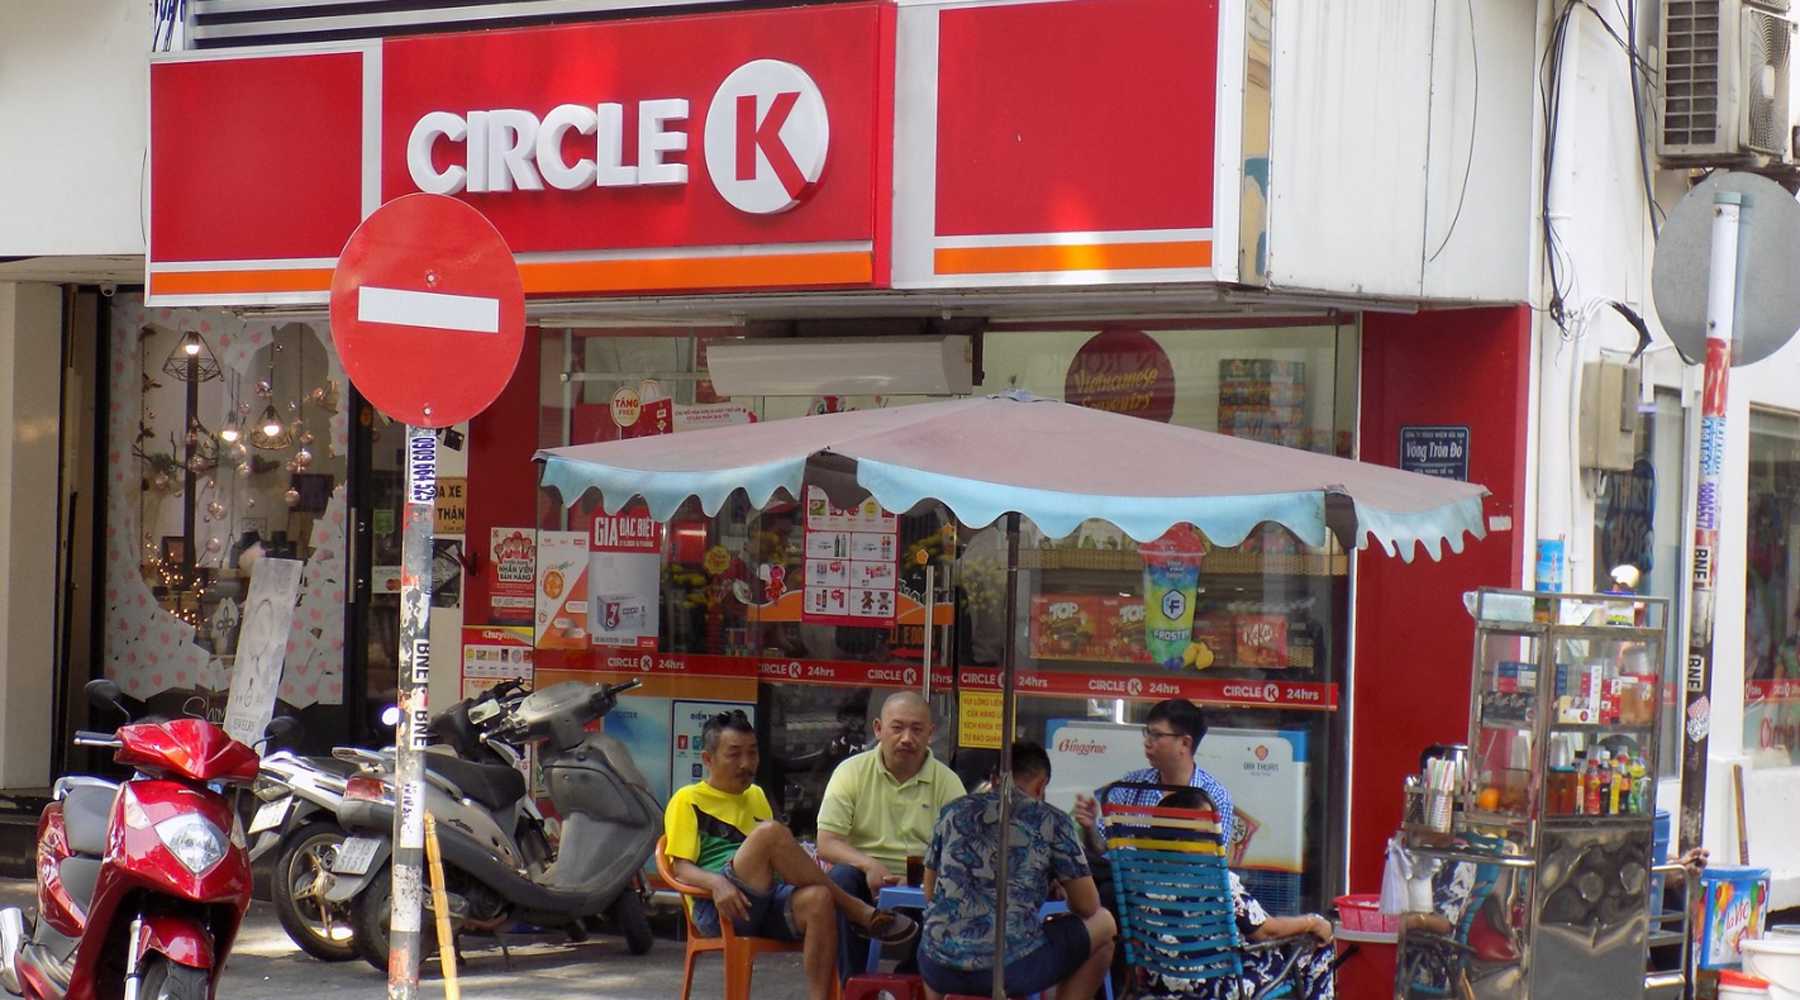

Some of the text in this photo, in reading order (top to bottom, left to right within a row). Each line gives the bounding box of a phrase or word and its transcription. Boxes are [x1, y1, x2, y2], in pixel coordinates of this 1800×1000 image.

[407, 98, 689, 195] CIRCLE
[1429, 441, 1448, 458] Tròn
[449, 486, 461, 497] XE
[416, 642, 430, 679] BNE
[608, 657, 638, 669] CIRCLE
[658, 658, 685, 670] 24hrs
[807, 666, 835, 677] 24hrs
[867, 669, 901, 681] CIRCLE
[961, 673, 996, 685] CIRCLE
[1018, 676, 1048, 689] 24hrs
[1088, 680, 1126, 692] CIRCLE
[1149, 683, 1180, 695] 24hrs
[1223, 685, 1262, 698] CIRCLE
[1286, 688, 1319, 701] 24hrs
[414, 710, 428, 747] BNE
